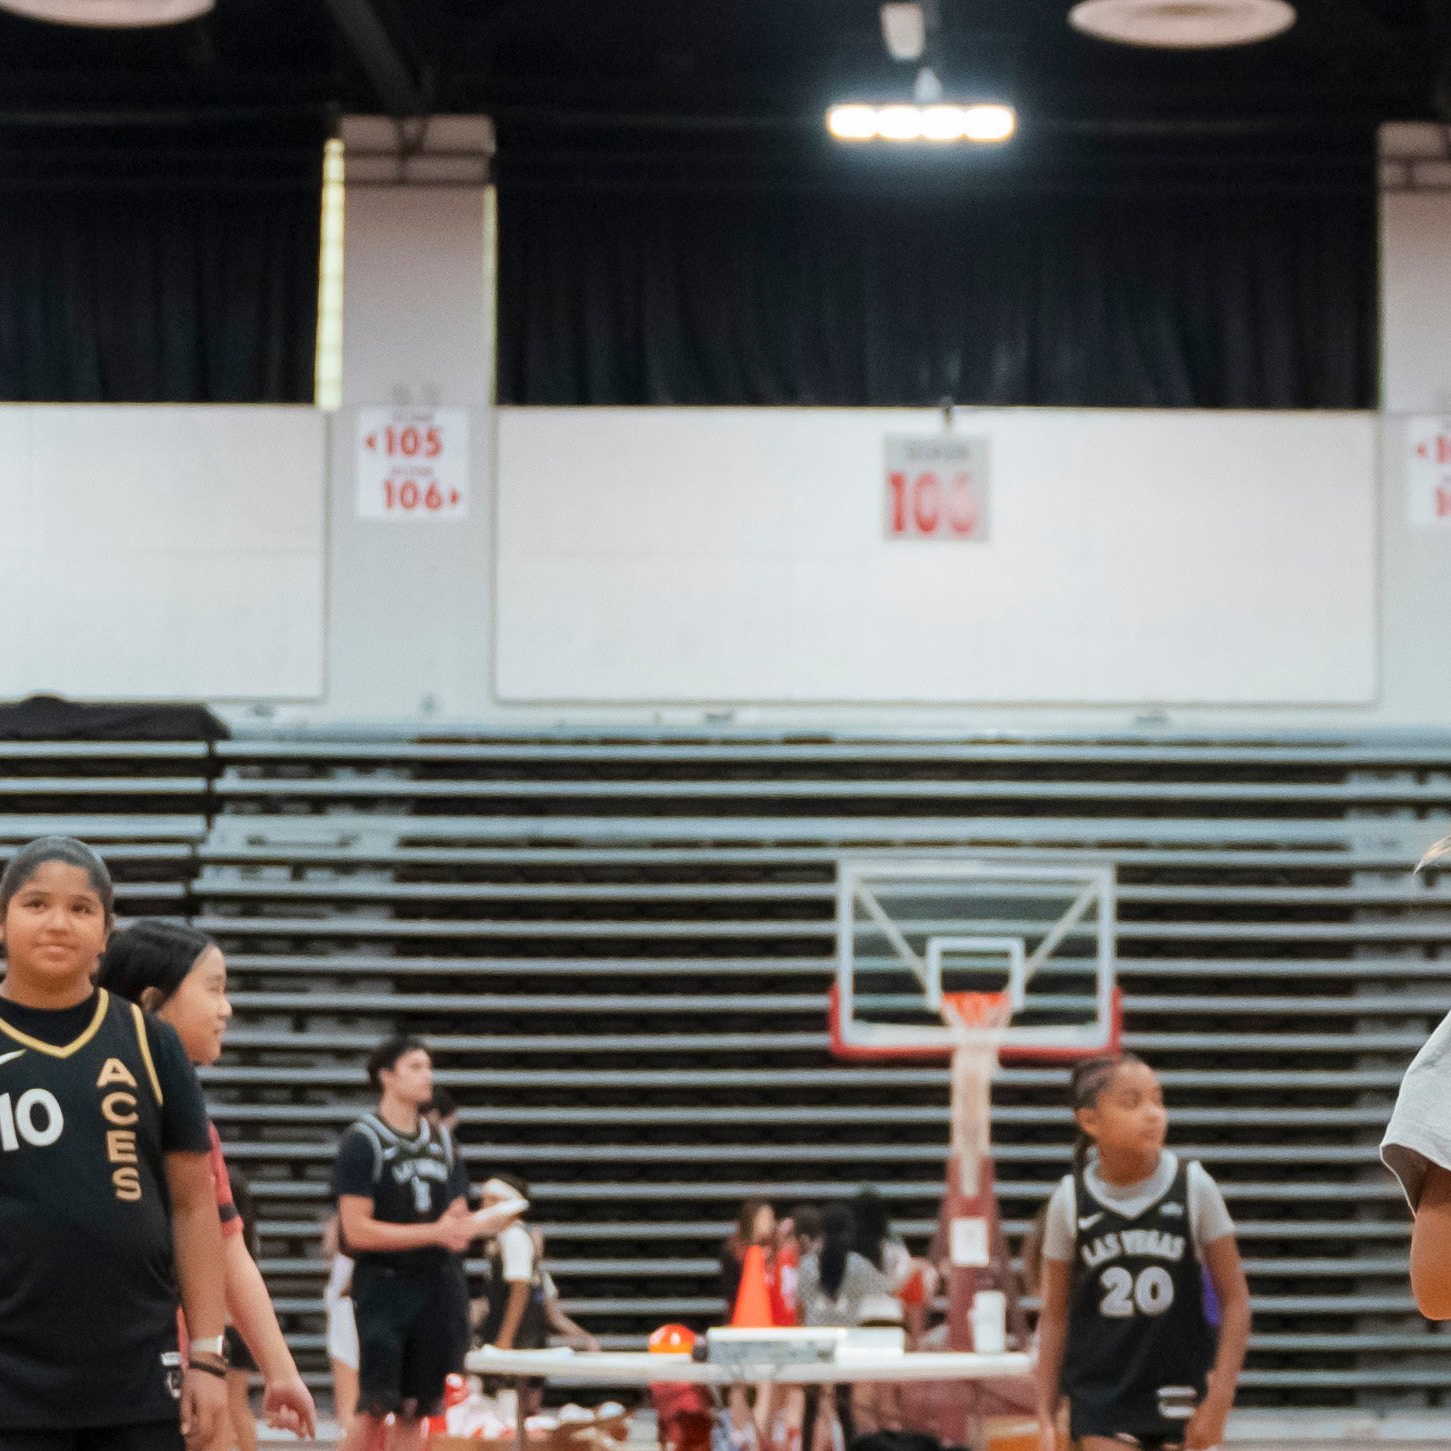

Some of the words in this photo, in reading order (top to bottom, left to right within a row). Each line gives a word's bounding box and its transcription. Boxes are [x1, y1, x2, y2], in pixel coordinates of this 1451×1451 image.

[384, 426, 444, 458] 105
[383, 479, 444, 511] 106
[96, 1057, 142, 1202] ACES
[1098, 1266, 1175, 1318] 20
